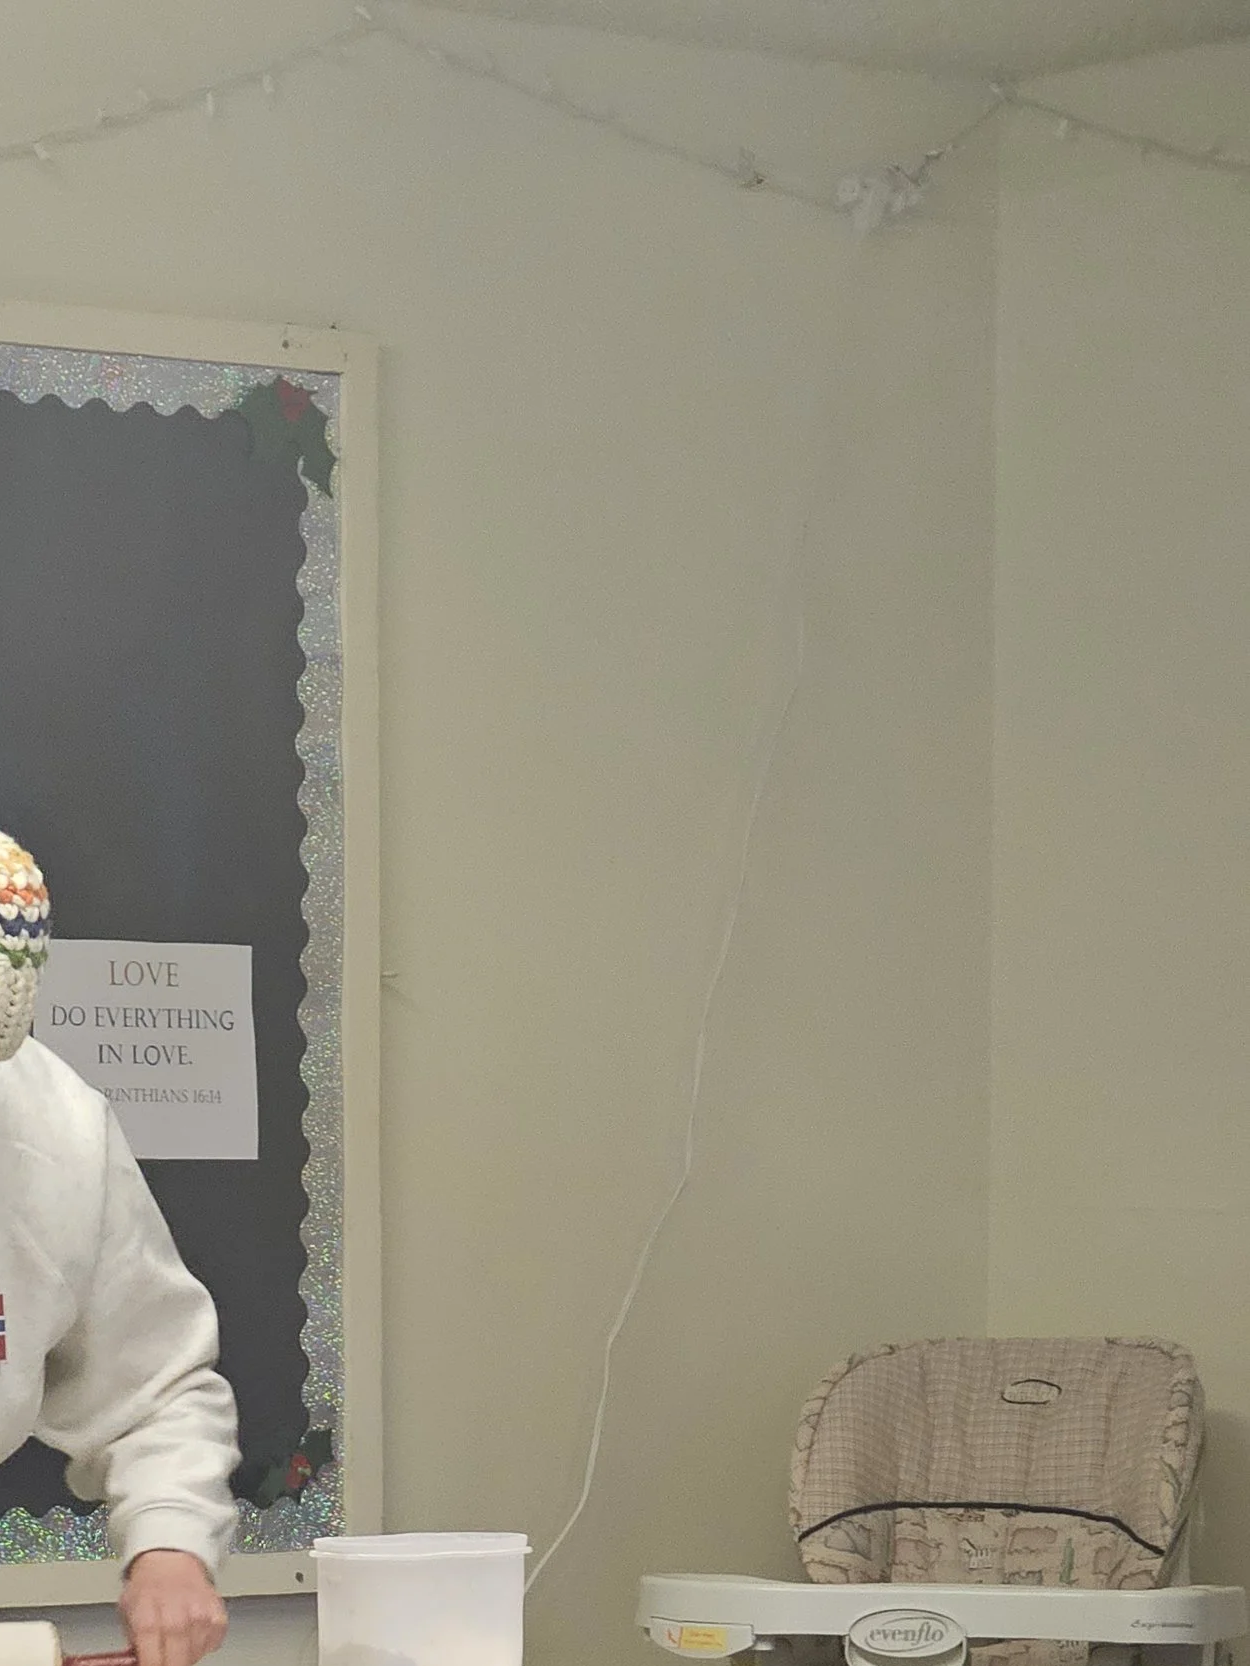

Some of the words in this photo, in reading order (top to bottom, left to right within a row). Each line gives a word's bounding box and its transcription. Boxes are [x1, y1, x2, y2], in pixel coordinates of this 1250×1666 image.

[108, 960, 180, 987] LOVE
[51, 1005, 86, 1027] DO
[94, 1006, 235, 1031] EVERYTHING
[97, 1043, 123, 1065] IN
[132, 1044, 193, 1066] LOVE.
[103, 1087, 188, 1104] ORINTHIANS
[869, 1621, 944, 1646] evenflo
